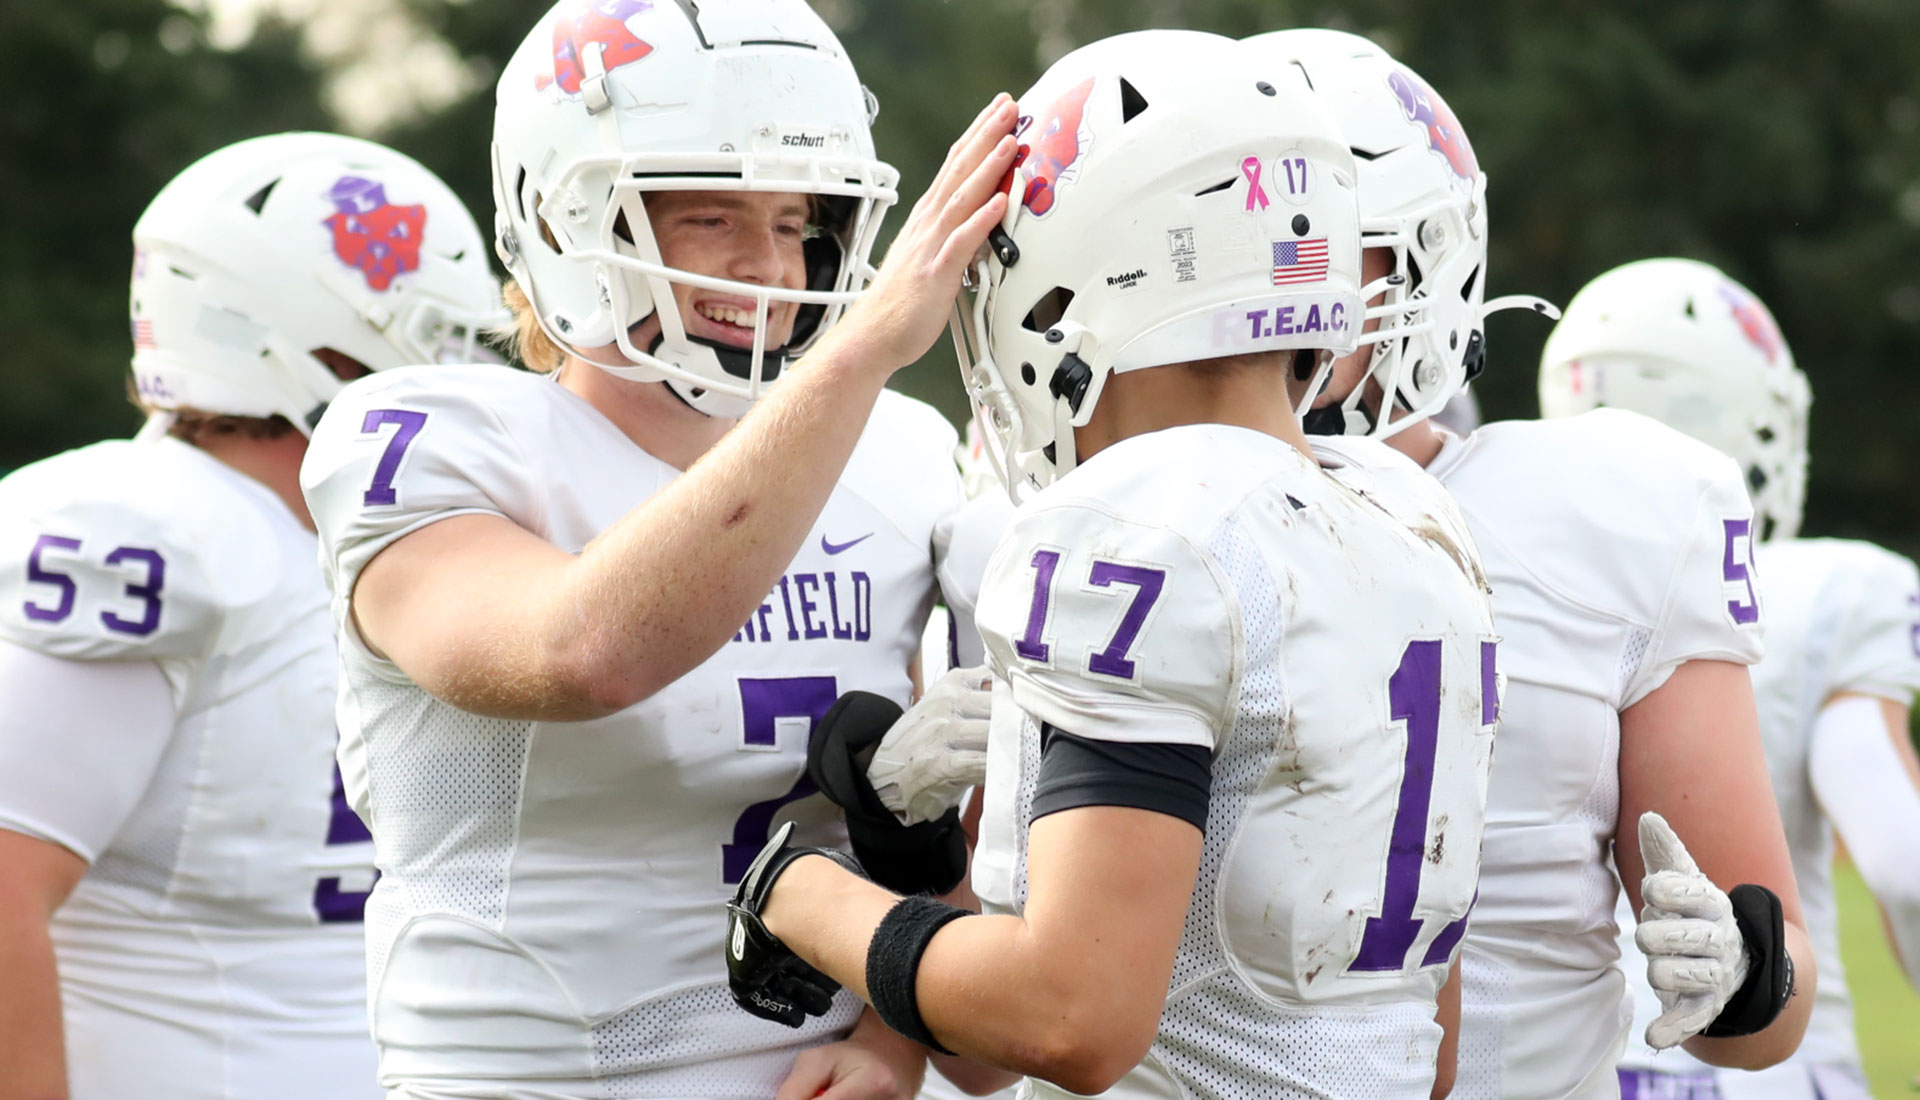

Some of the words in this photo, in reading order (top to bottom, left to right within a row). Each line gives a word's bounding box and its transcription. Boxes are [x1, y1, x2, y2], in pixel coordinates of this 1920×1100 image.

[781, 132, 825, 148] schutt
[1282, 158, 1306, 194] 17
[1246, 302, 1348, 339] T.E.A.C.
[361, 410, 428, 506] 7
[24, 534, 165, 636] 53
[1015, 550, 1166, 678] 17
[1722, 519, 1758, 624] 5
